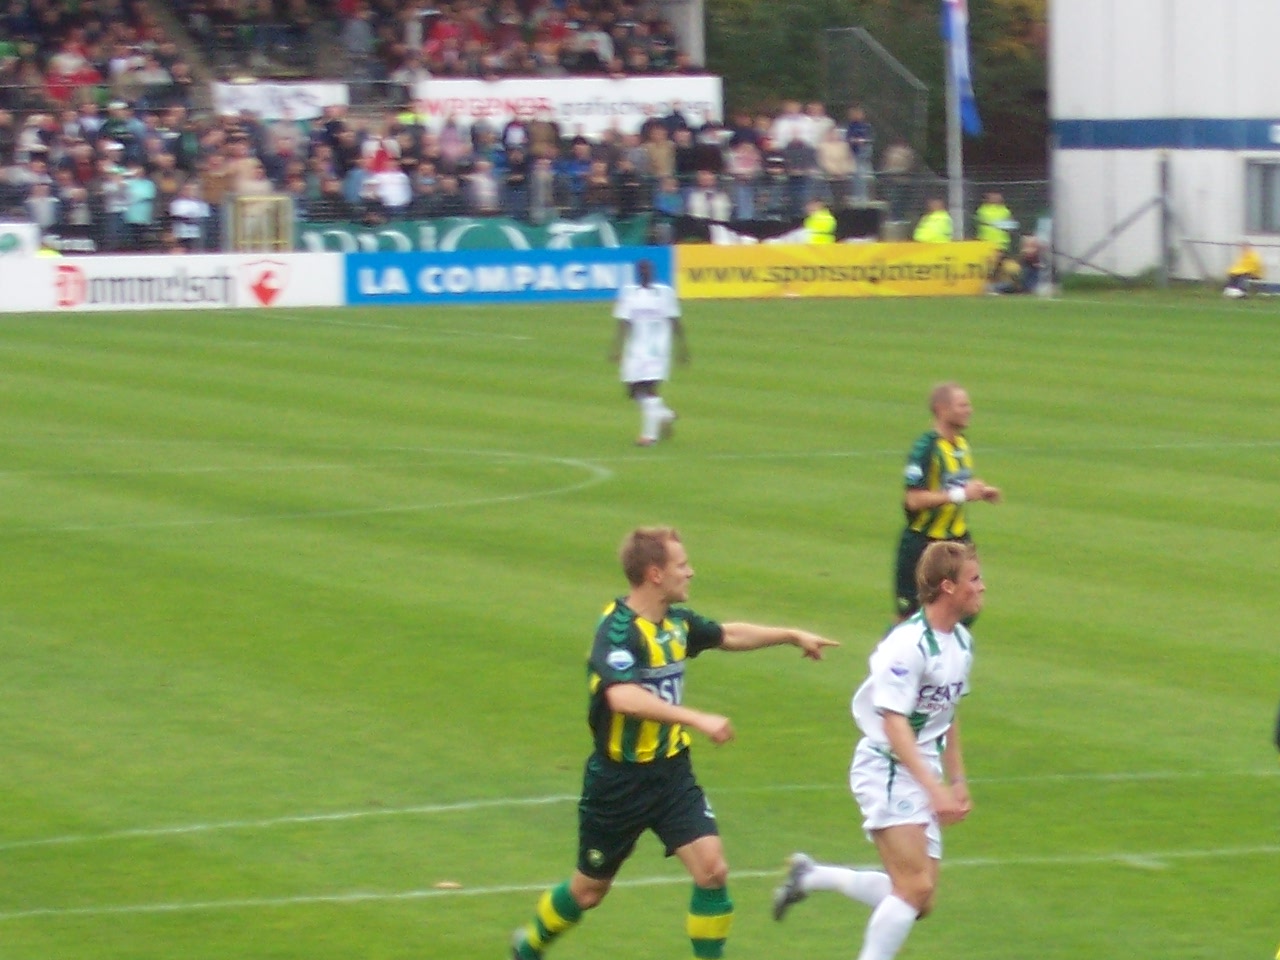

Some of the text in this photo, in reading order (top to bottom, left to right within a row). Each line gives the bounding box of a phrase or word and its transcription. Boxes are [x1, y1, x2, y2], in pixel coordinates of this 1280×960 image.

[55, 264, 237, 308] Dommelsch
[358, 261, 640, 295] LA COMPAGNI
